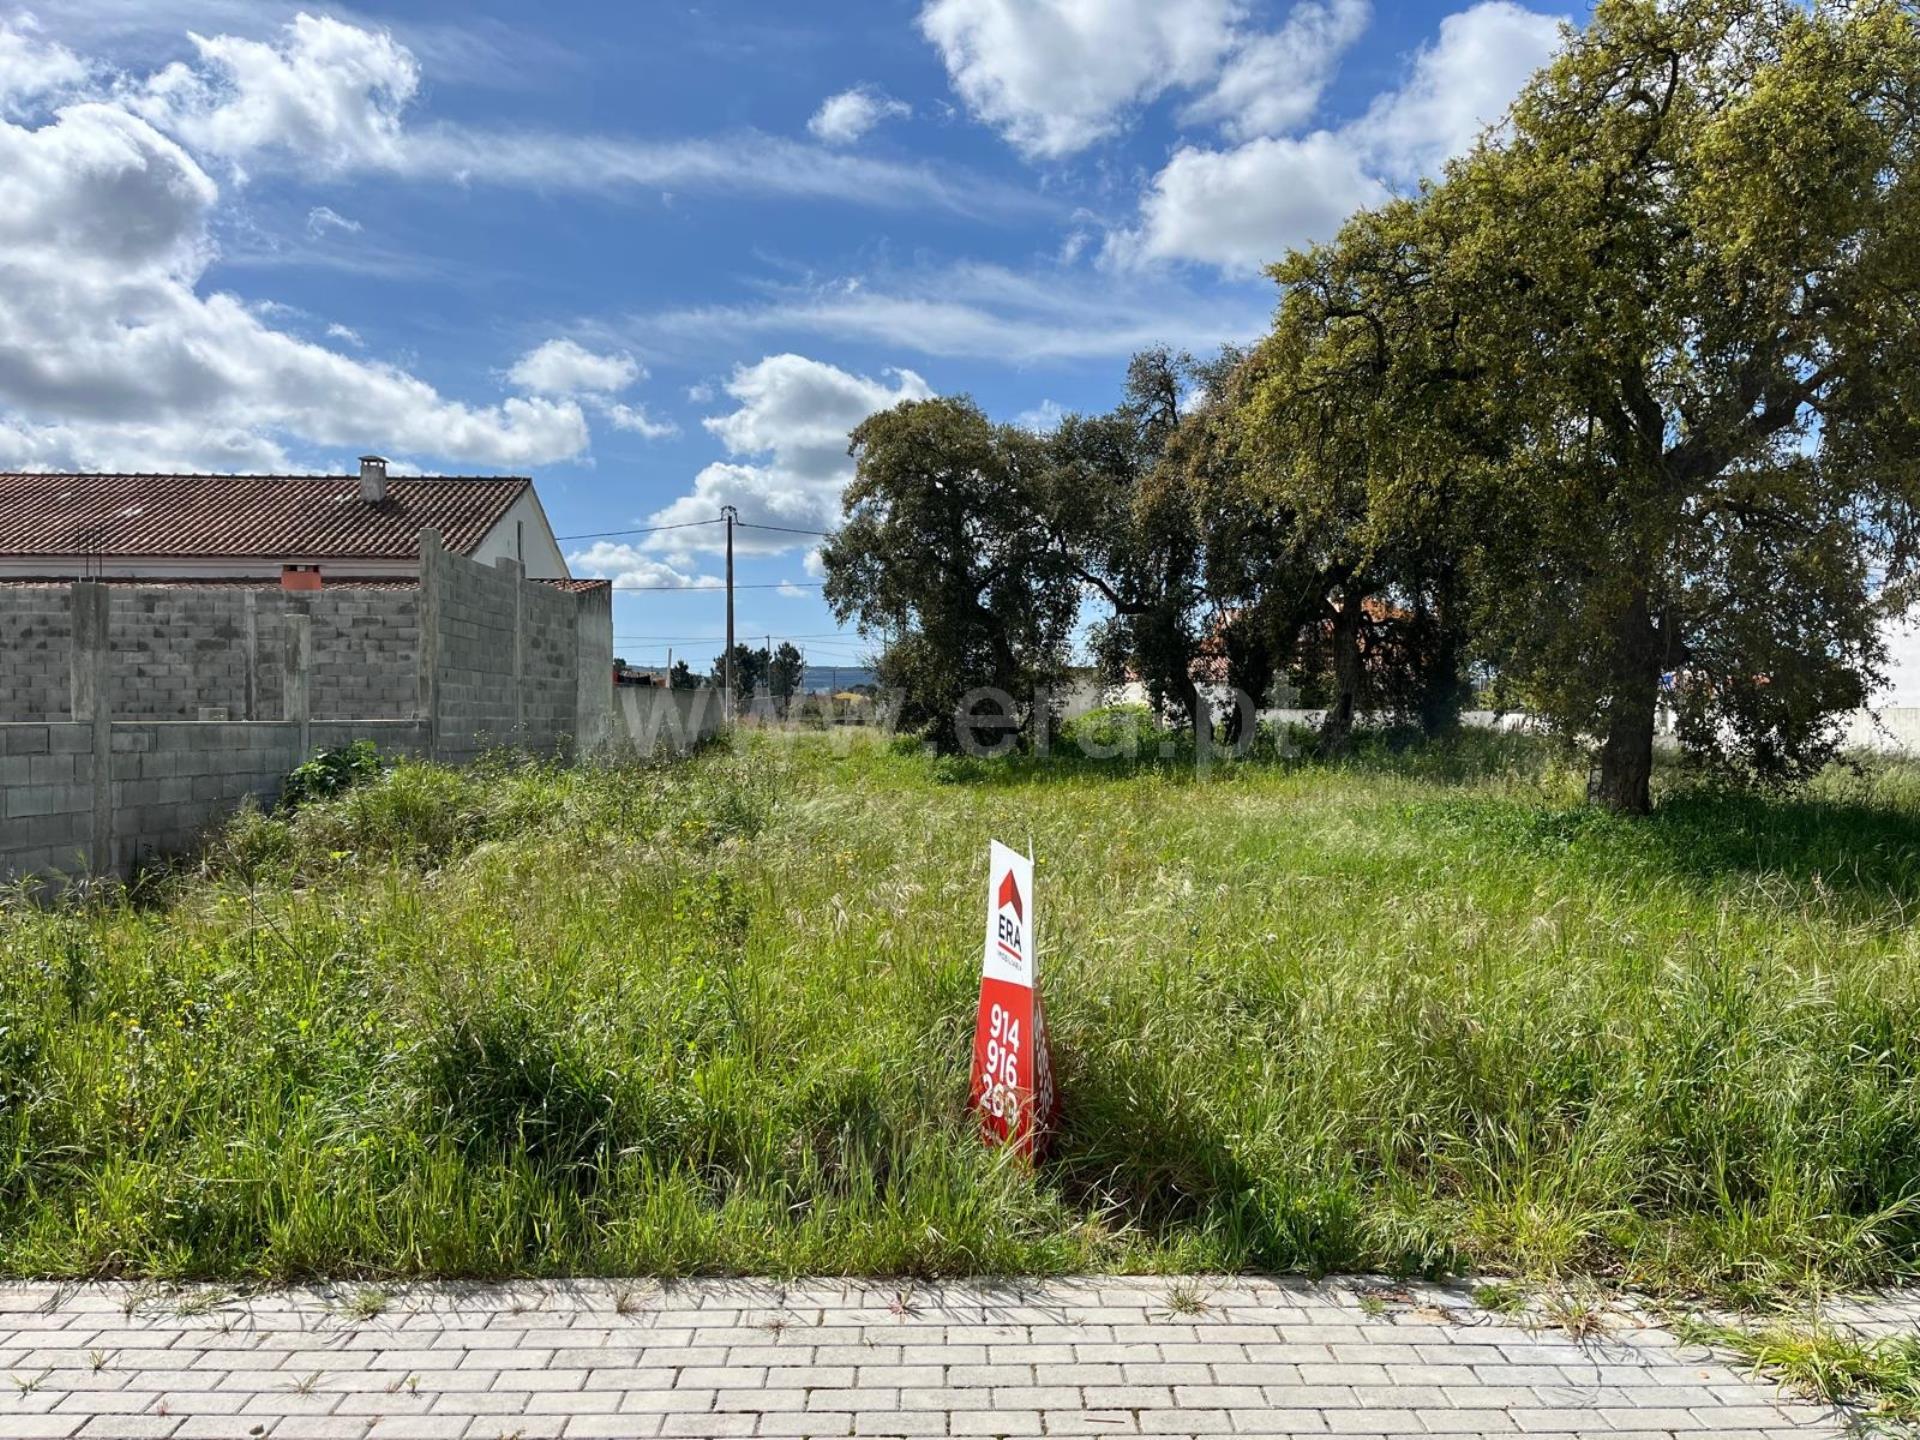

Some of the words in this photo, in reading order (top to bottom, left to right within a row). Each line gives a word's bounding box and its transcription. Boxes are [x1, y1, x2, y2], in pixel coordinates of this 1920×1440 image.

[998, 914, 1022, 953] ERA
[990, 1003, 1019, 1053] 914
[986, 1039, 1018, 1089] 916
